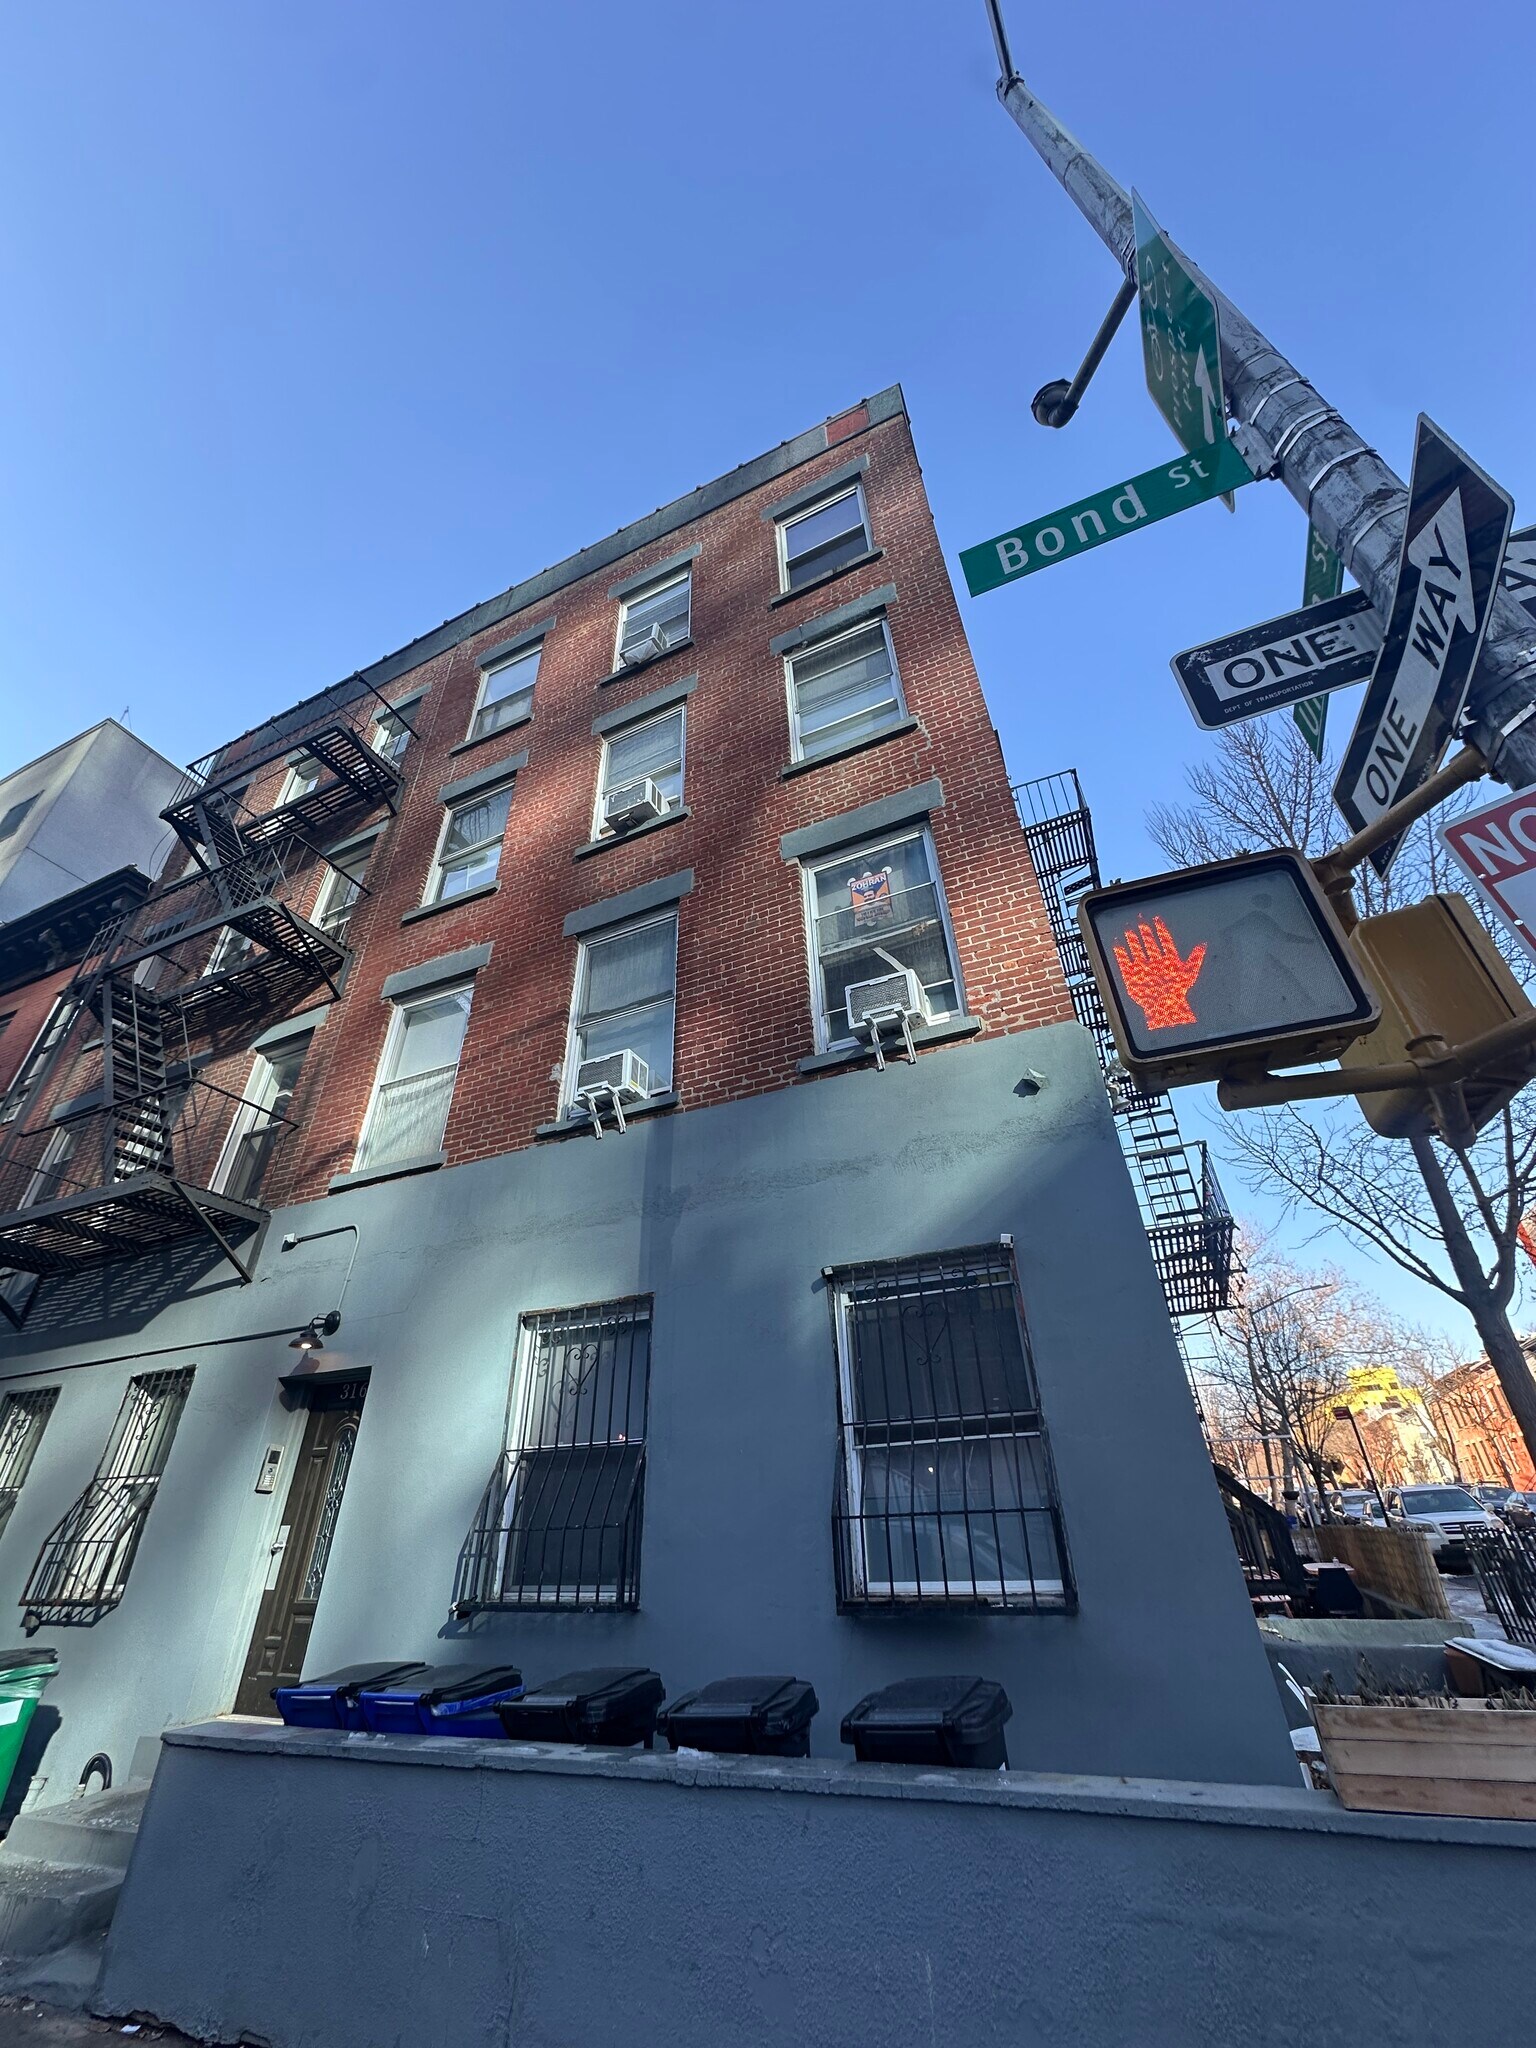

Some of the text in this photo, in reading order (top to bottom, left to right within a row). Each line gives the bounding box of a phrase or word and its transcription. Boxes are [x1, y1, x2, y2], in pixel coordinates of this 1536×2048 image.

[995, 459, 1209, 575] Bond St
[1223, 624, 1357, 689] ONE
[1366, 523, 1462, 806] ONE WAY
[1224, 680, 1314, 714] DEPT OF TRANSPORTATION
[851, 874, 887, 891] ZOHRAN
[340, 1382, 368, 1400] 316
